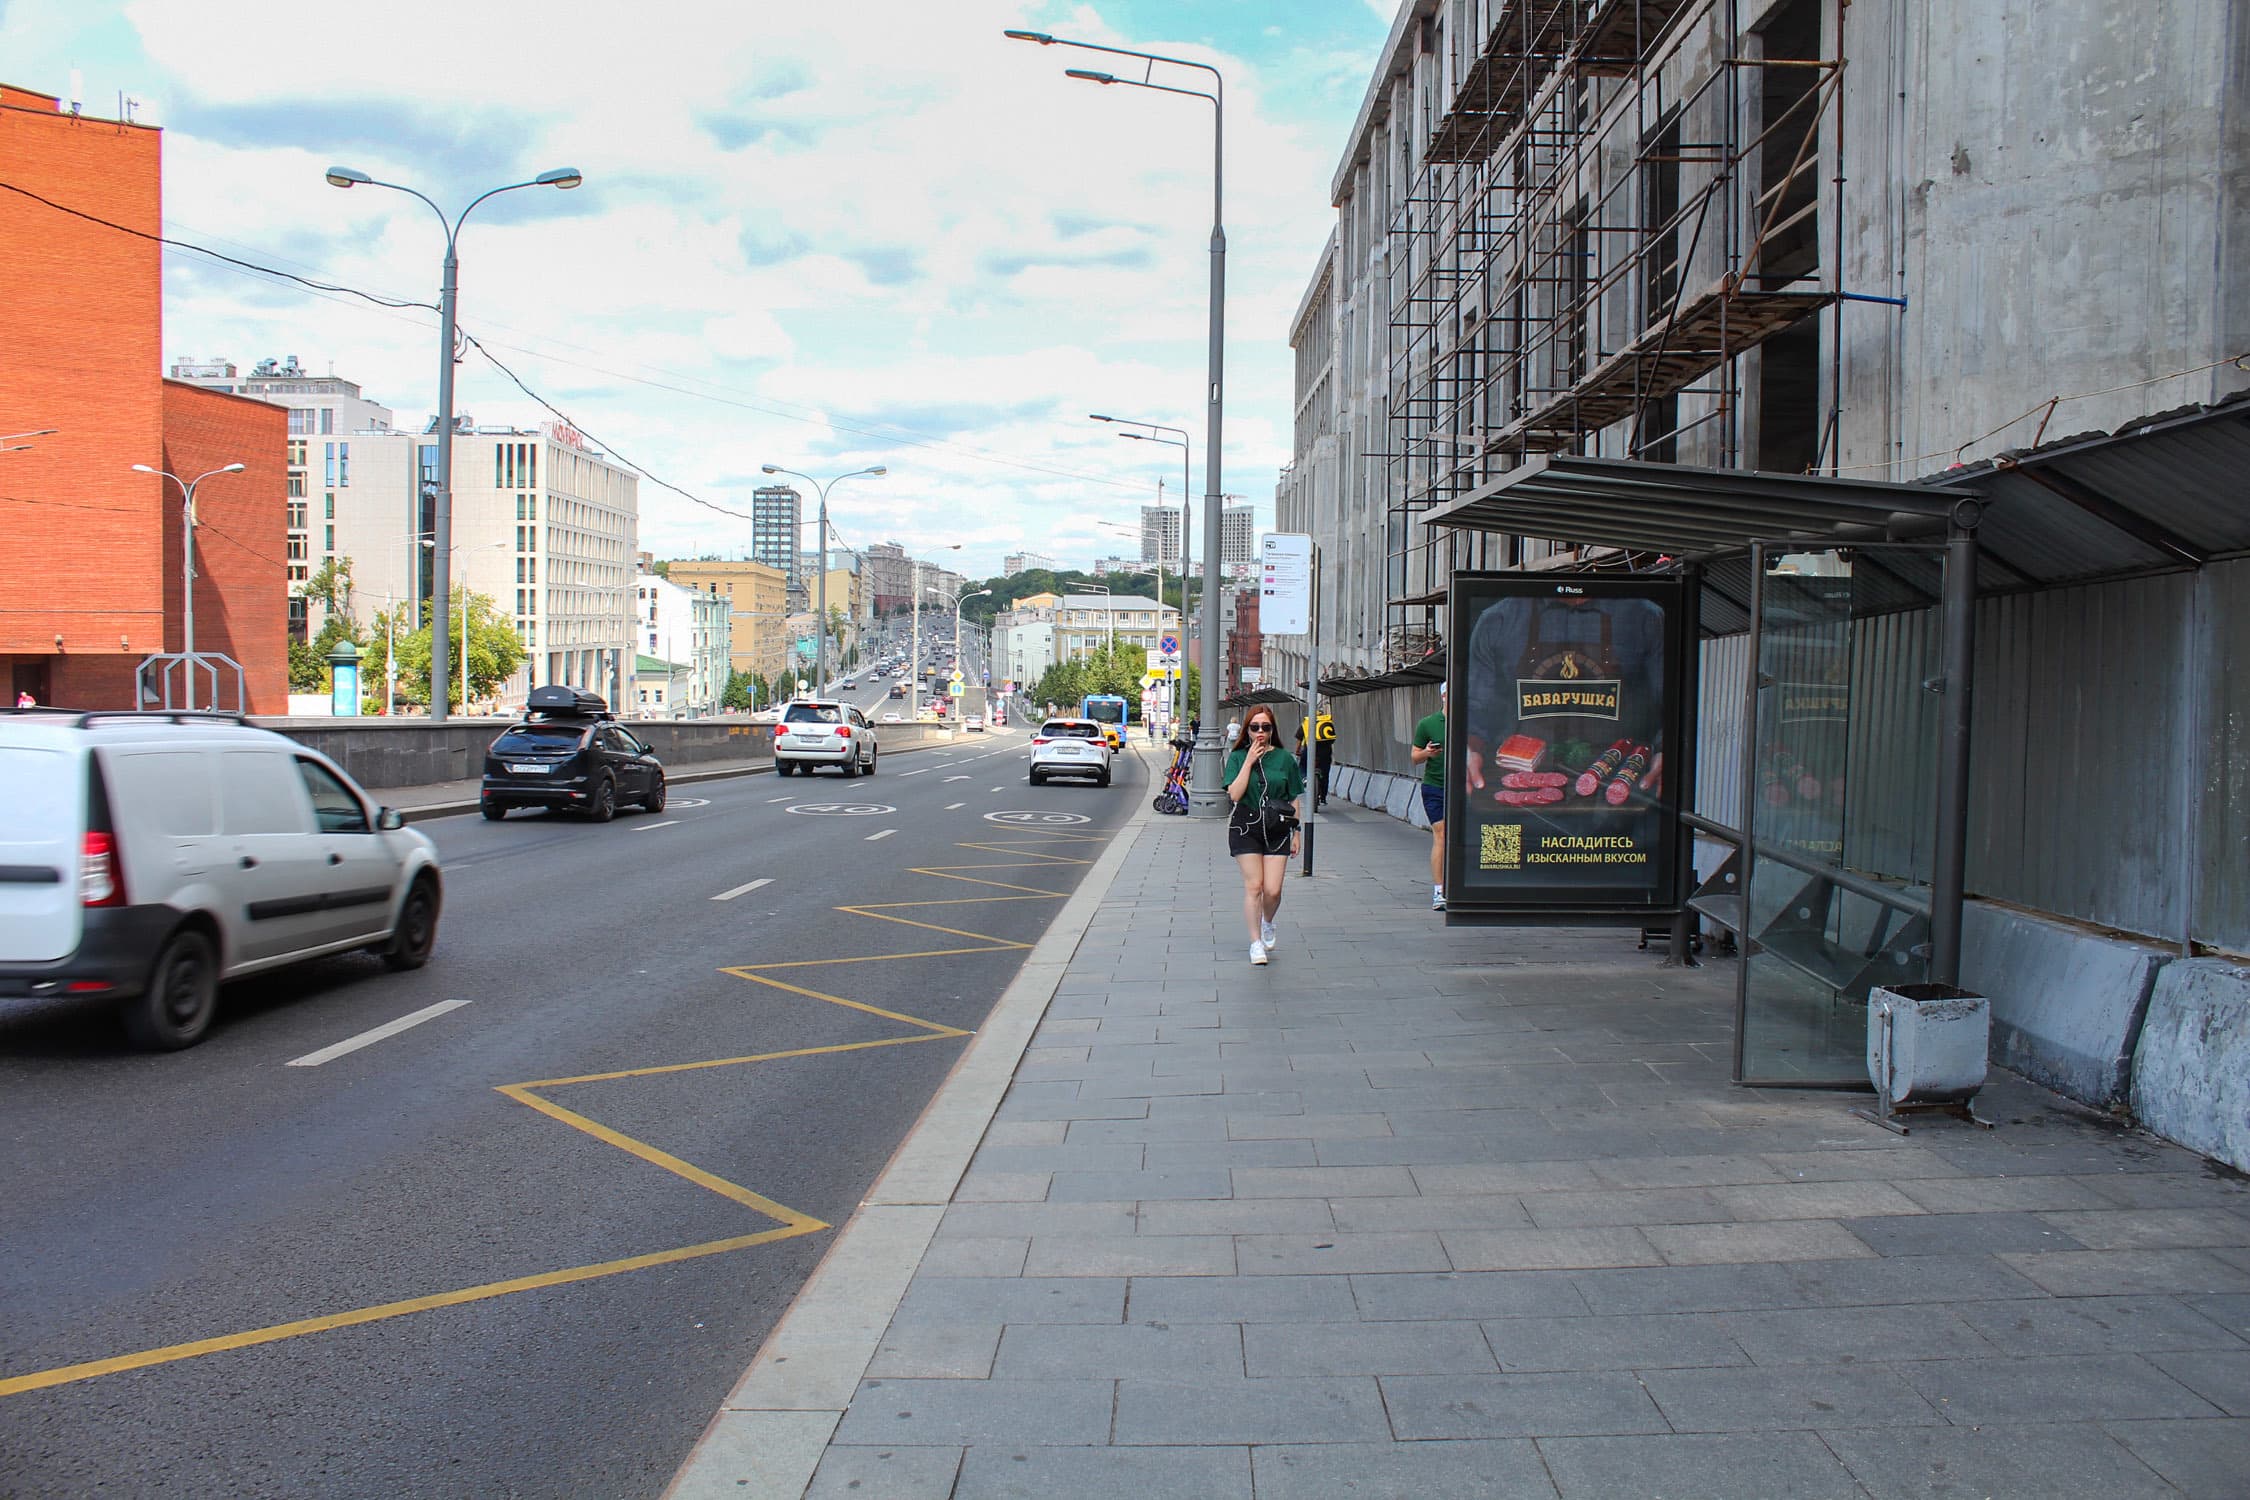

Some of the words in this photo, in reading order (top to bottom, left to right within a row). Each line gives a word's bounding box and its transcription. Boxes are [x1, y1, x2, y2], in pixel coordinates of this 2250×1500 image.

[1565, 586, 1583, 594] Russ
[1522, 692, 1616, 707] БАВАРУШКА
[1541, 836, 1634, 850] НАСЛАДИТЕСЬ
[1526, 853, 1602, 863] ИЗЫСКАННЫМ
[1604, 853, 1647, 863] ВКУСОМ
